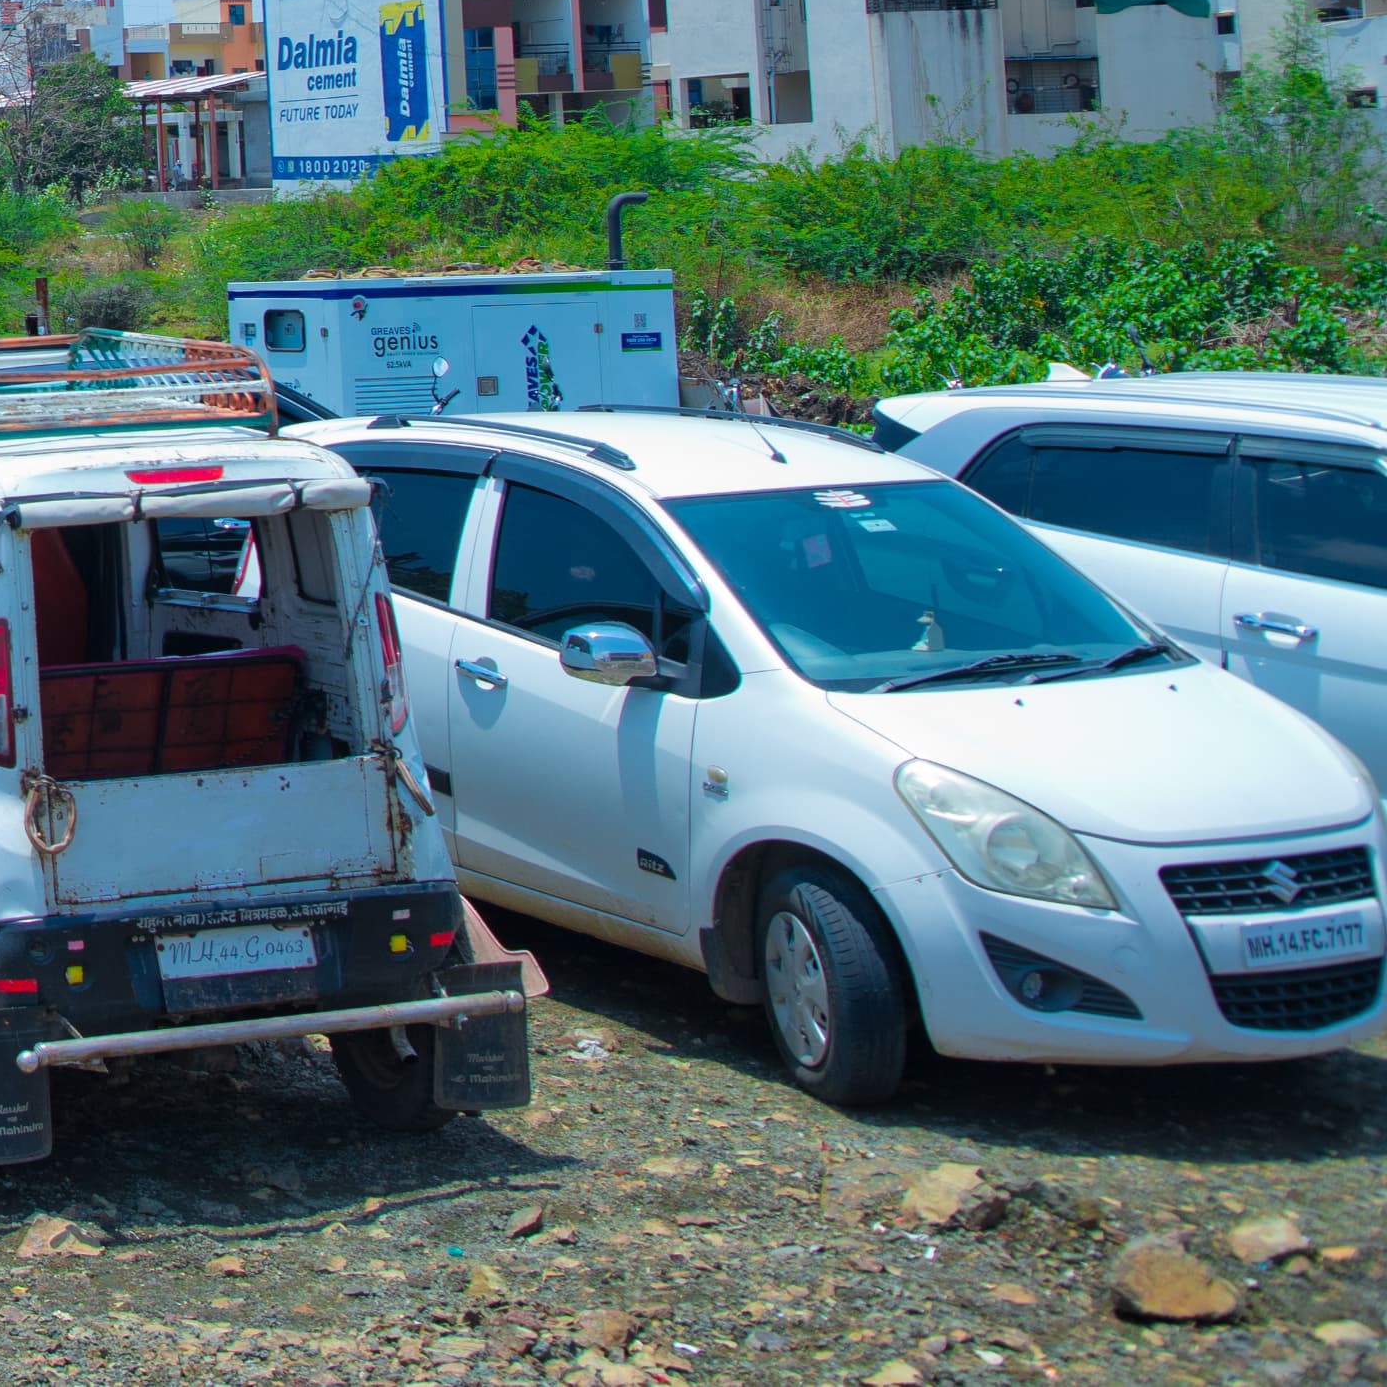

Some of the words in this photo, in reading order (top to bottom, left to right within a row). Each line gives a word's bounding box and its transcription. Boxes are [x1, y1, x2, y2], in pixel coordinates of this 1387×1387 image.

[277, 29, 358, 72] Dalmia
[307, 68, 357, 92] cement
[399, 36, 410, 118] Dalmia
[279, 105, 320, 124] FUTURE
[324, 103, 359, 119] TODAY
[371, 326, 410, 336] GREAVES
[373, 330, 438, 357] genius
[640, 857, 665, 873] Ritz
[1247, 922, 1364, 960] MH.14.FC.7177
